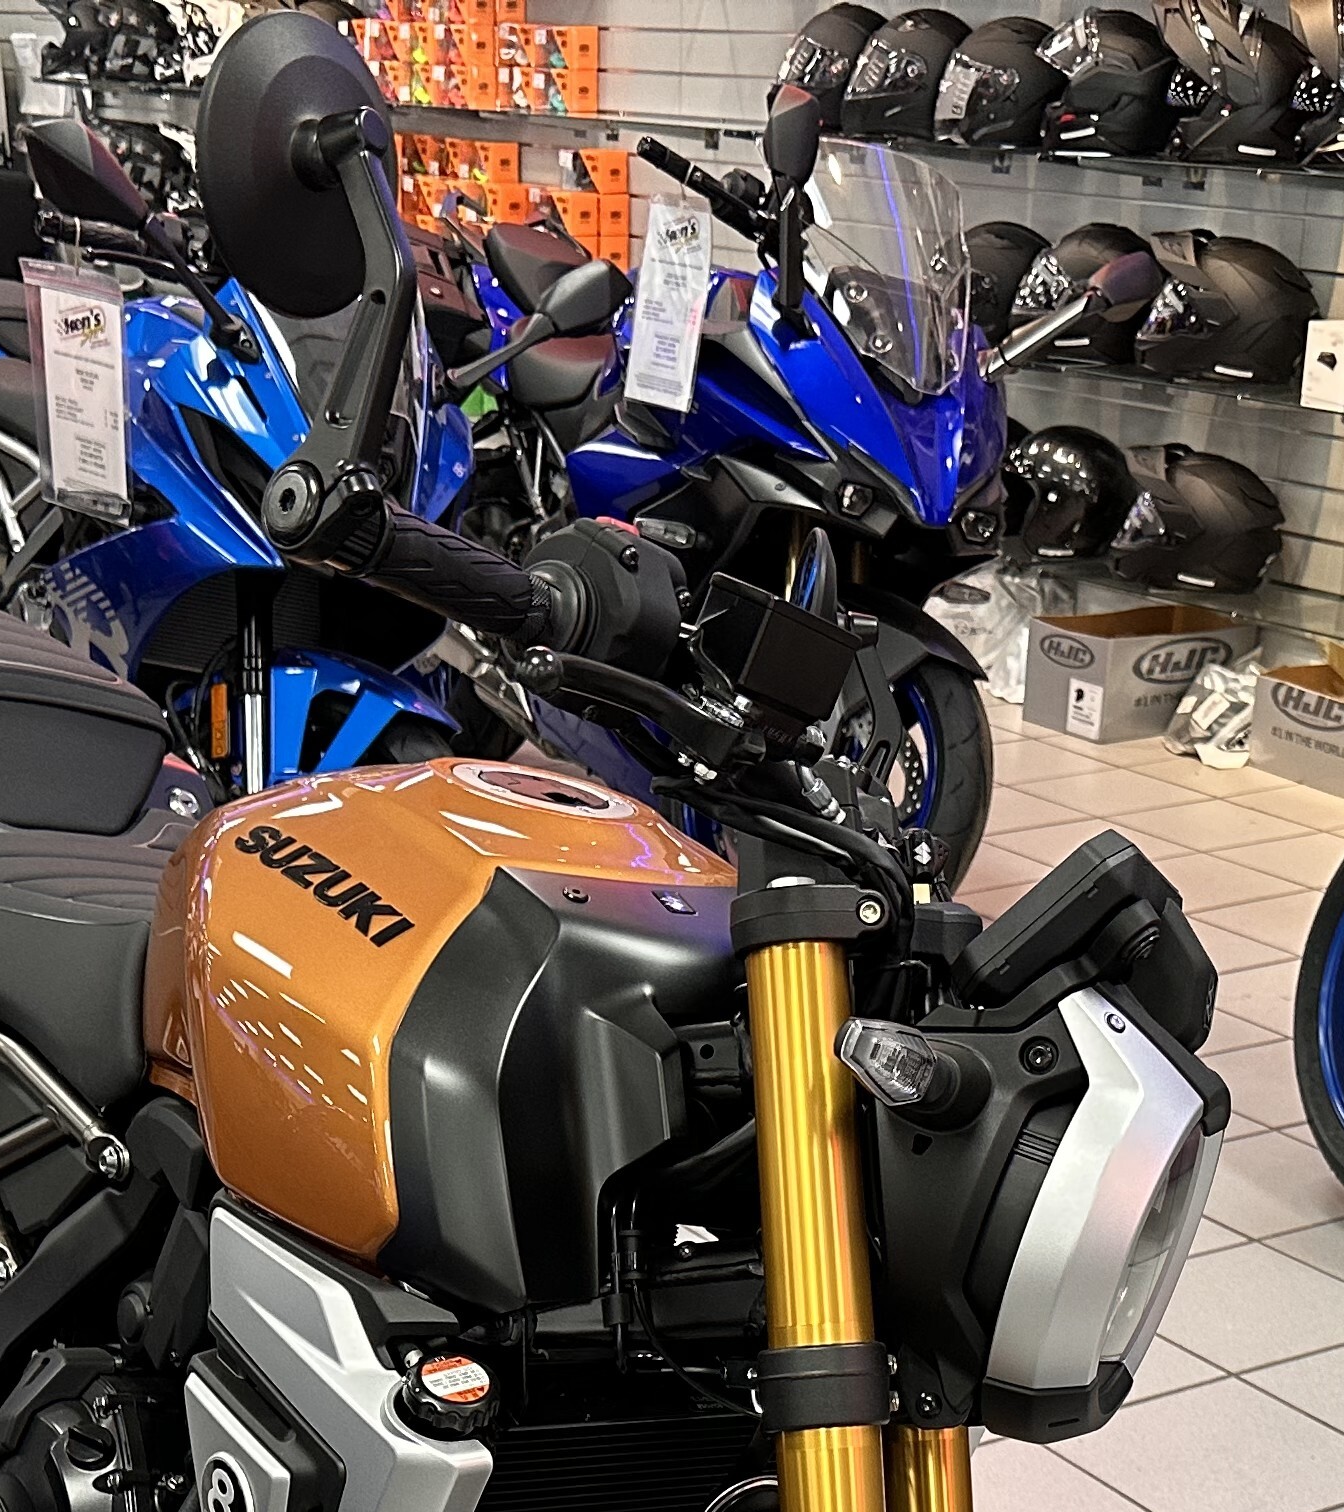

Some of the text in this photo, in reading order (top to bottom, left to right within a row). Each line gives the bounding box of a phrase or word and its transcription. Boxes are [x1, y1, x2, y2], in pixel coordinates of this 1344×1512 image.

[1046, 640, 1088, 664] HJC
[1294, 731, 1313, 749] THE
[234, 825, 416, 948] SUZUKI
